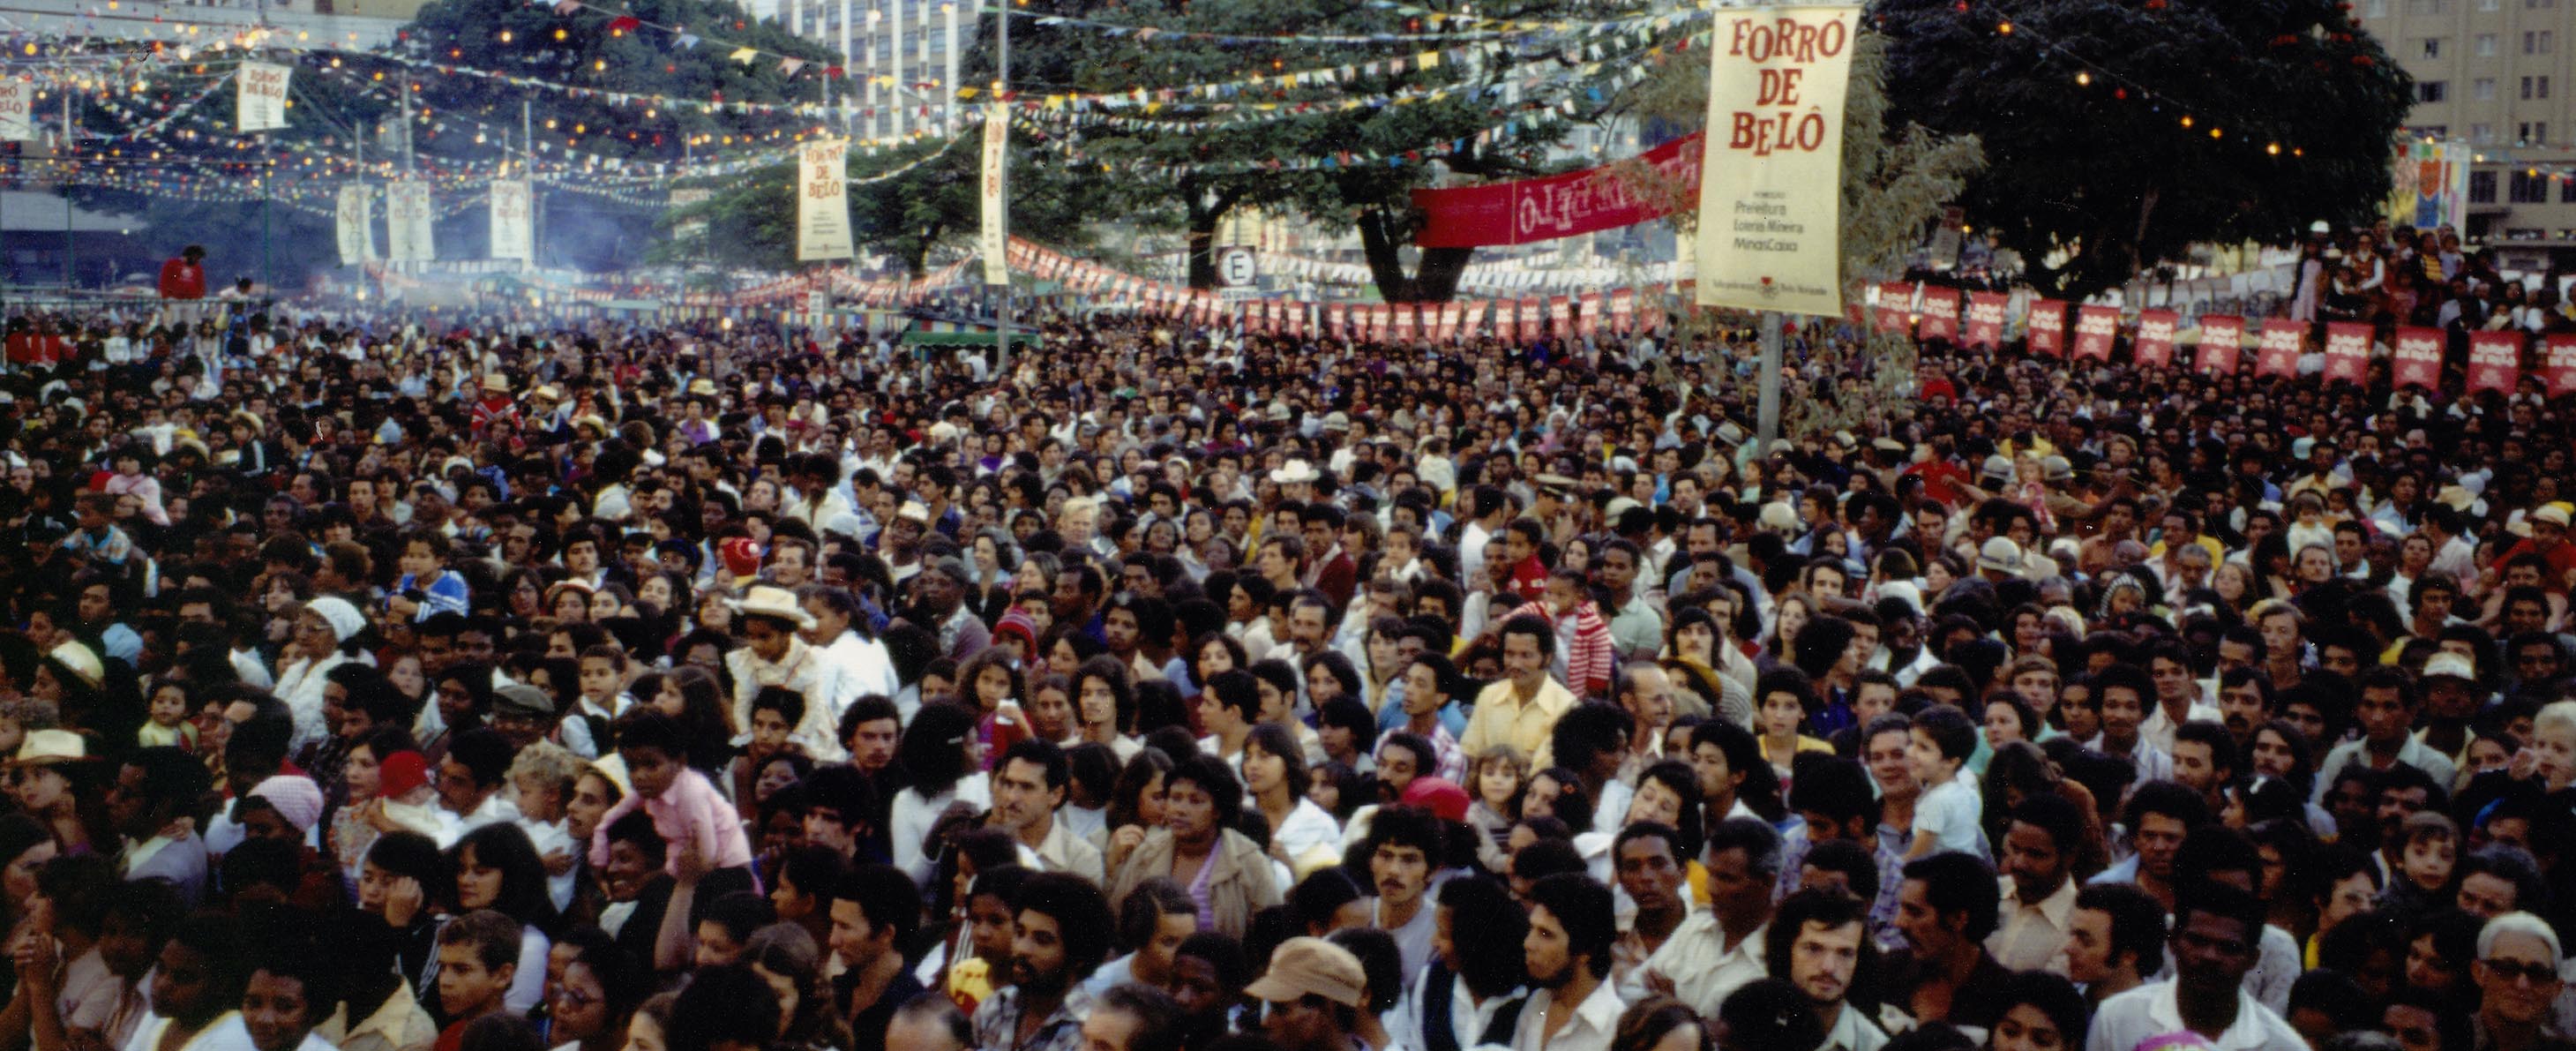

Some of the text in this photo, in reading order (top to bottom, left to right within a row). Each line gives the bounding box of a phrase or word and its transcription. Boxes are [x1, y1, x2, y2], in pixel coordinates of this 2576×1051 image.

[1729, 11, 1846, 64] FORRÓ
[1756, 68, 1802, 106] DE
[1729, 105, 1824, 157] BELÔ
[1232, 254, 1245, 280] E
